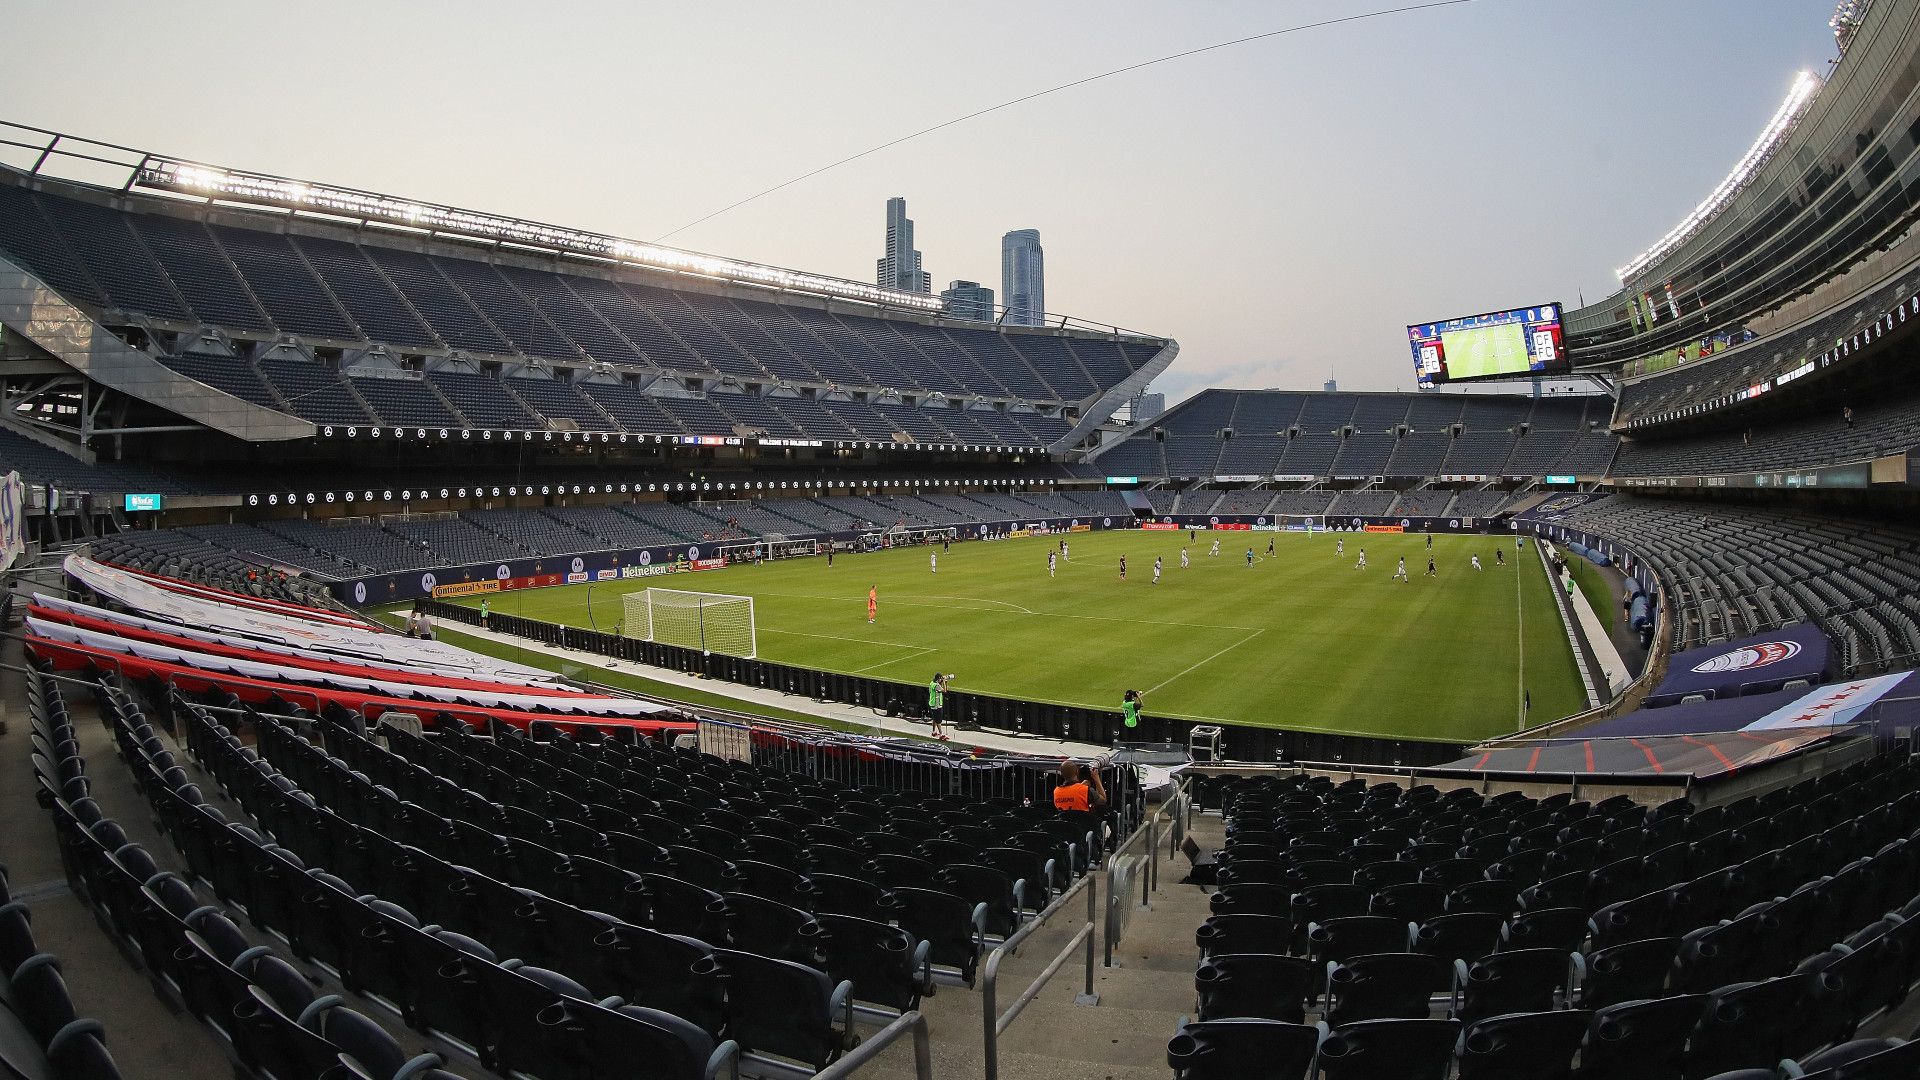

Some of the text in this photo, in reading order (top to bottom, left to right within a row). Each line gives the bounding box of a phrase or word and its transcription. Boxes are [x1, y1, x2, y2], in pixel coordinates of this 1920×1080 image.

[1528, 309, 1535, 321] 0
[1430, 325, 1437, 336] 2
[1536, 334, 1549, 346] CF
[1424, 349, 1435, 359] CF
[1539, 346, 1553, 358] FC
[1426, 360, 1438, 371] FC
[622, 564, 667, 578] Heineken
[435, 582, 475, 597] Continental
[482, 582, 498, 590] TIRE
